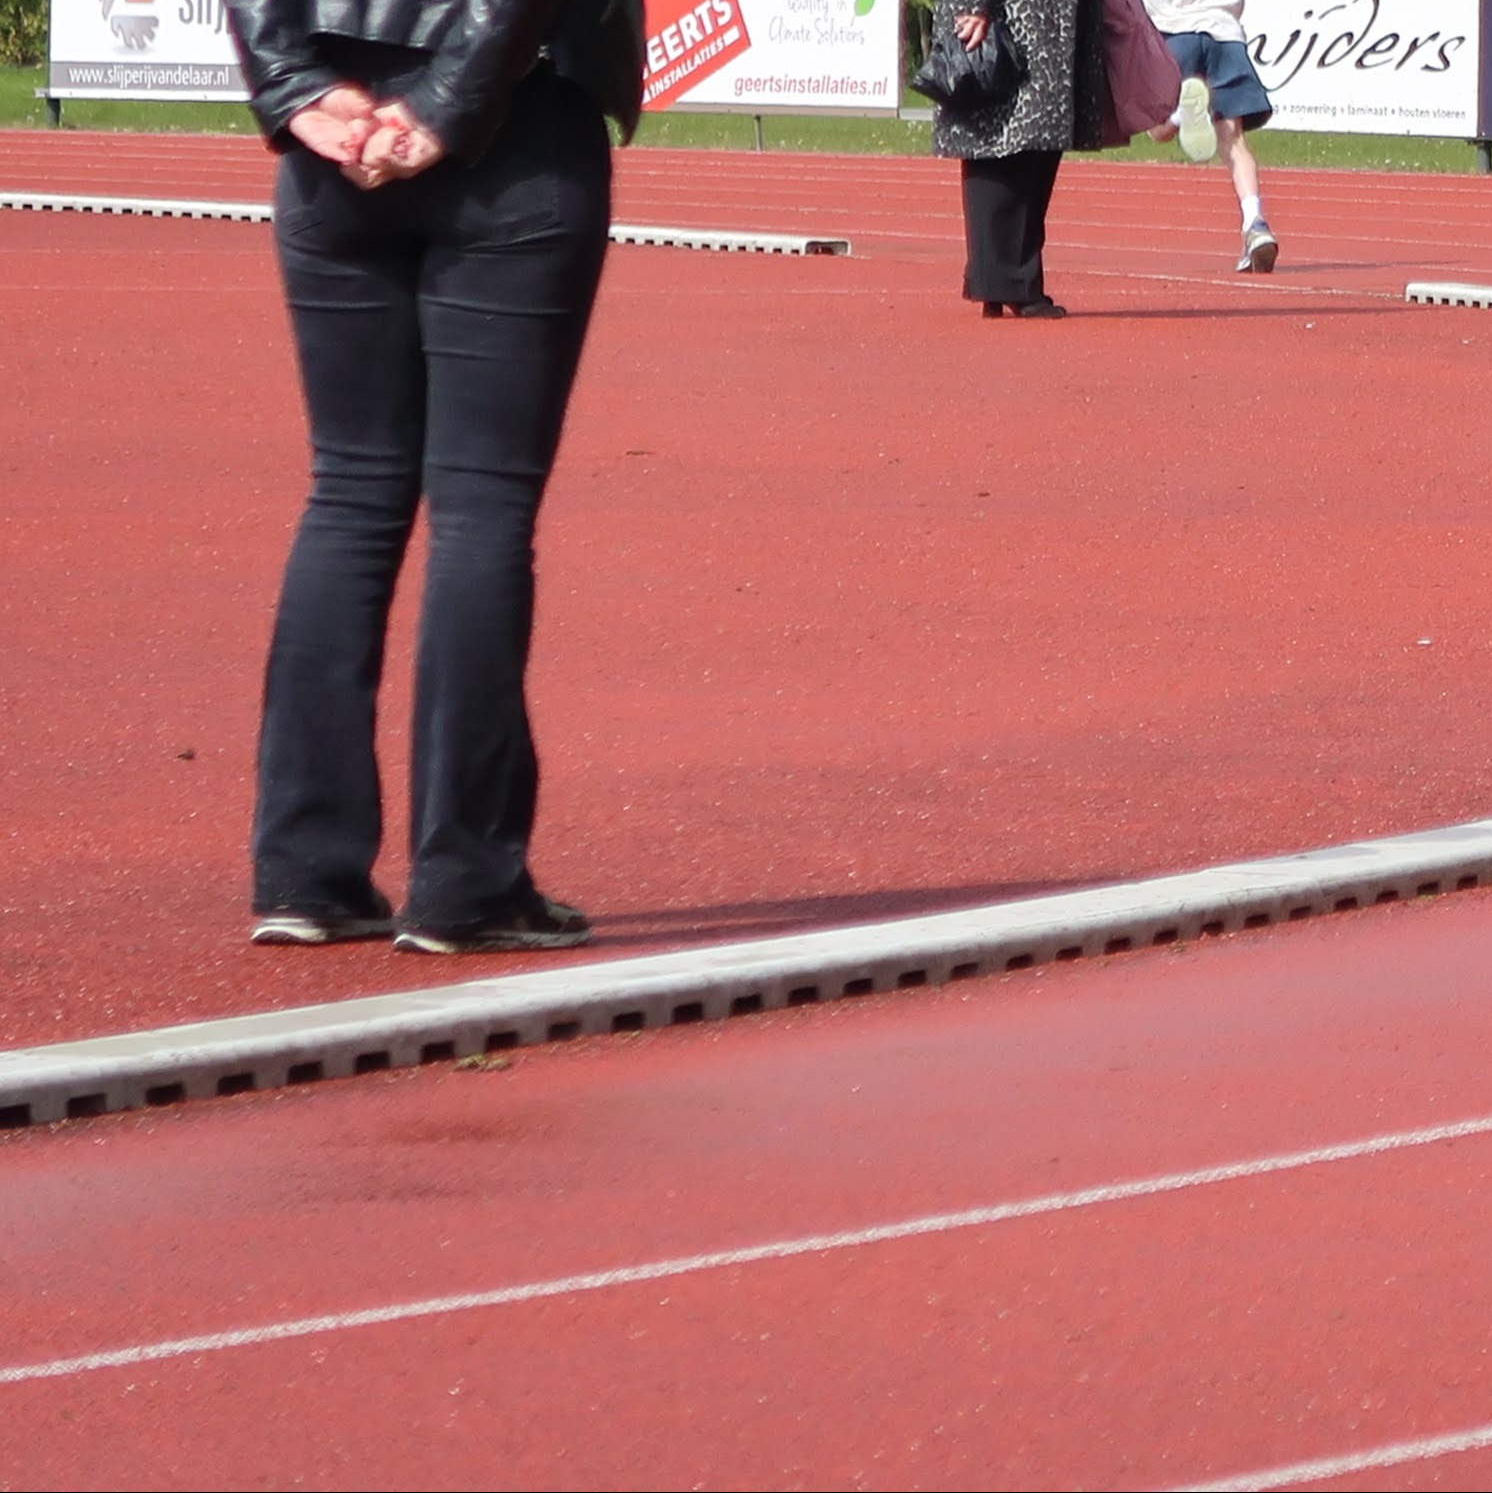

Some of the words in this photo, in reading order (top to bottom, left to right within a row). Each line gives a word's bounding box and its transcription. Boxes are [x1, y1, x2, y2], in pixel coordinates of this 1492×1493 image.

[69, 64, 230, 89] www.slijperijvandelaar.nl
[650, 35, 726, 100] INSTALLATIES
[734, 73, 889, 97] geertsinstallaties.nl
